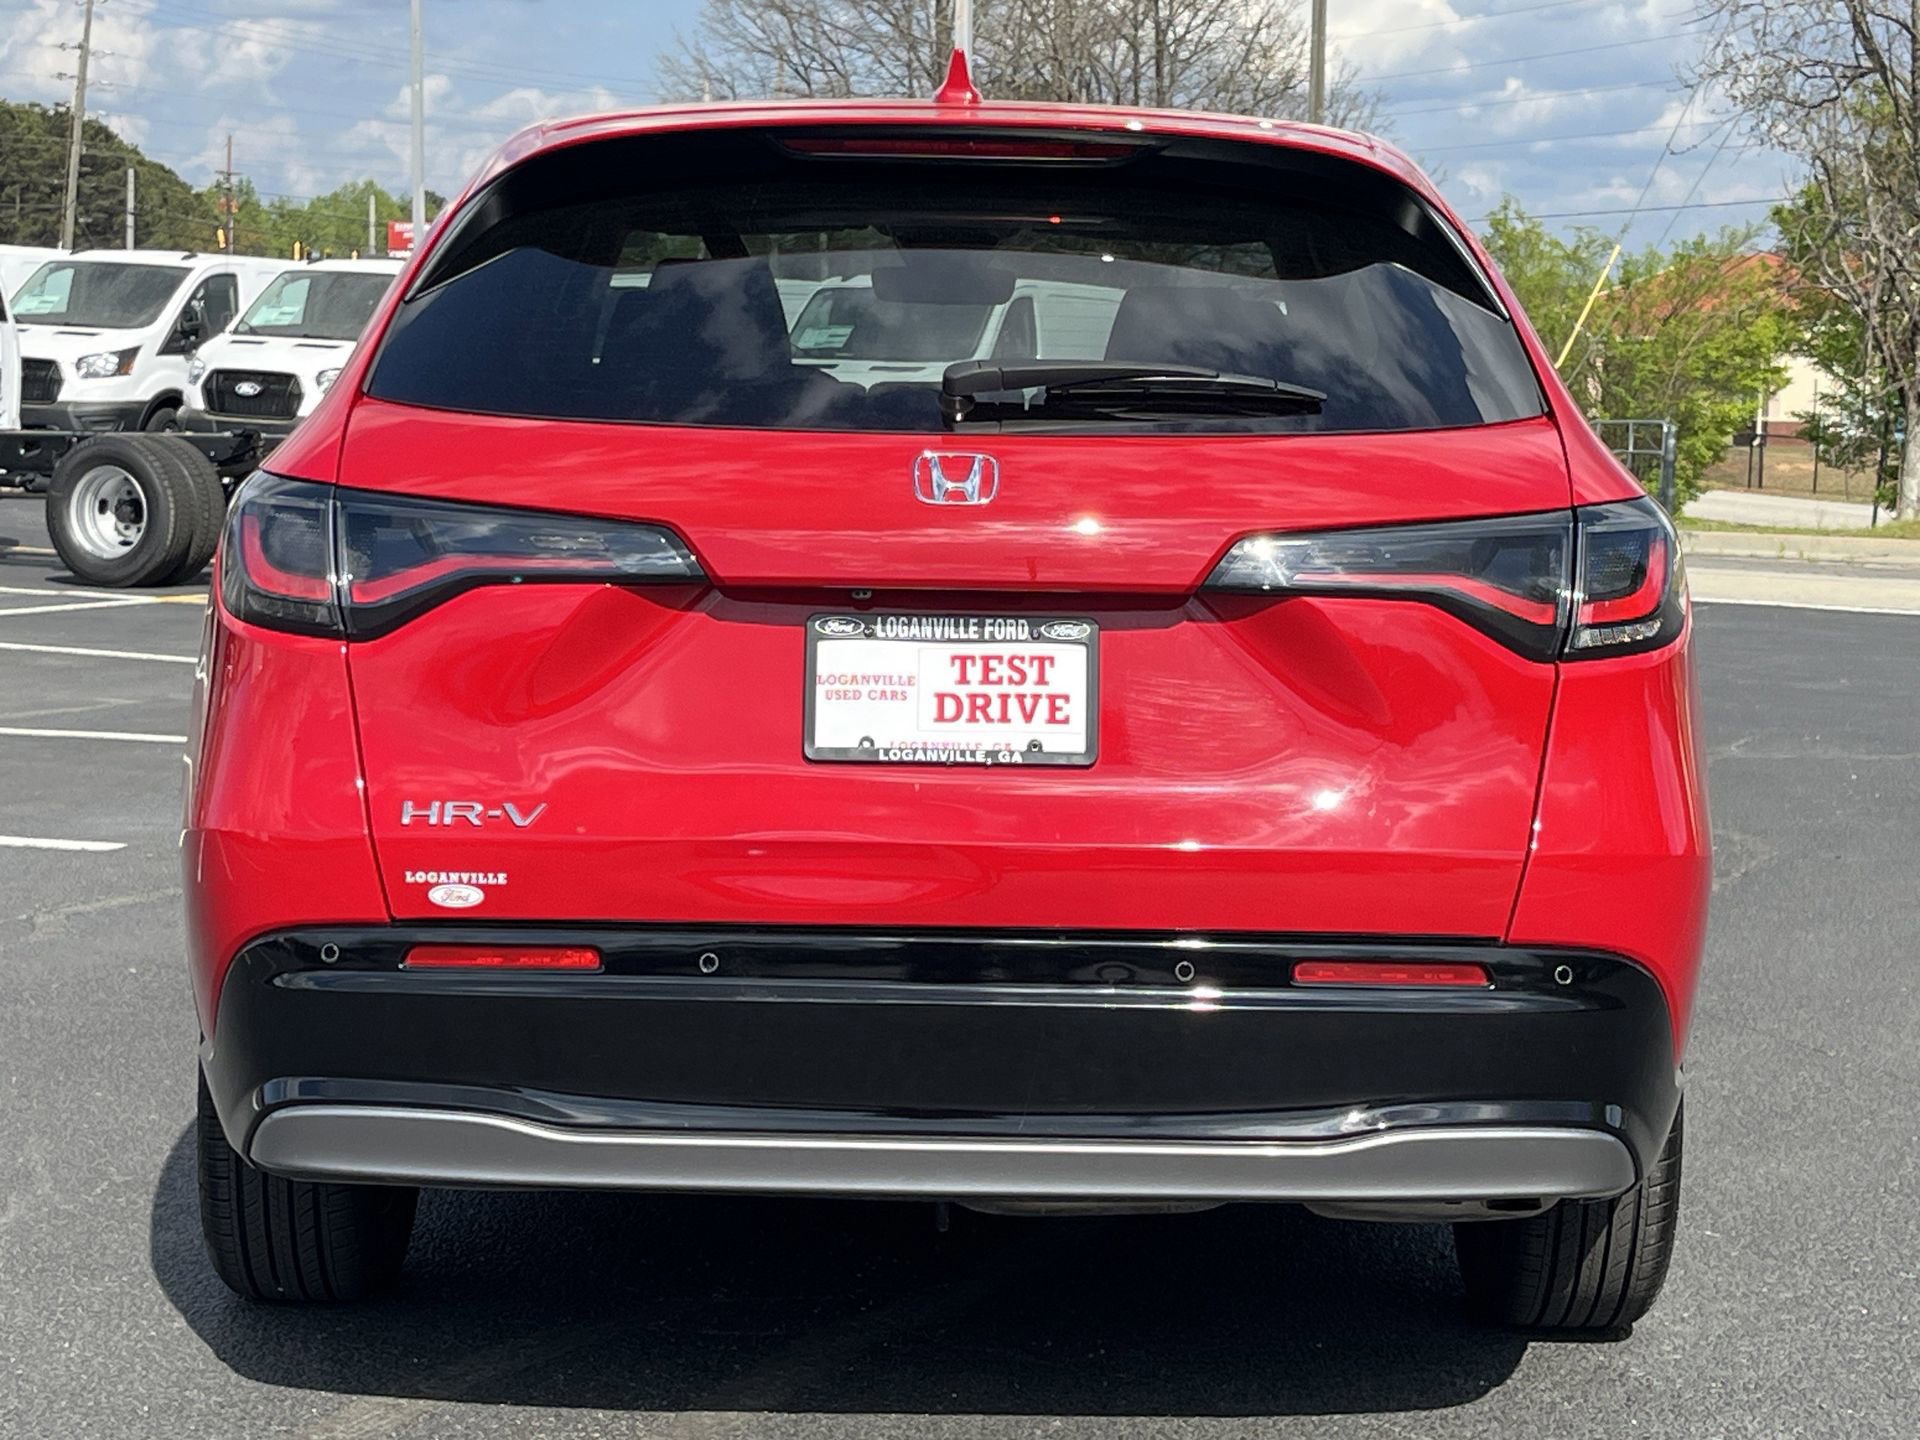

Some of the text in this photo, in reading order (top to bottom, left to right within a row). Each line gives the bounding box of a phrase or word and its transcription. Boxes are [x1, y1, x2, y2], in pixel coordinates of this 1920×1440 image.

[876, 616, 1029, 640] LOGANVILLE FORD
[950, 655, 1055, 685] TEST
[816, 675, 916, 686] LOGANVILLE
[825, 690, 908, 701] USED CARS
[933, 693, 1071, 724] DRIVE
[878, 749, 1023, 764] LOGANVILLE, GA
[401, 800, 548, 827] HR-V
[404, 871, 508, 885] LOGANVILLE
